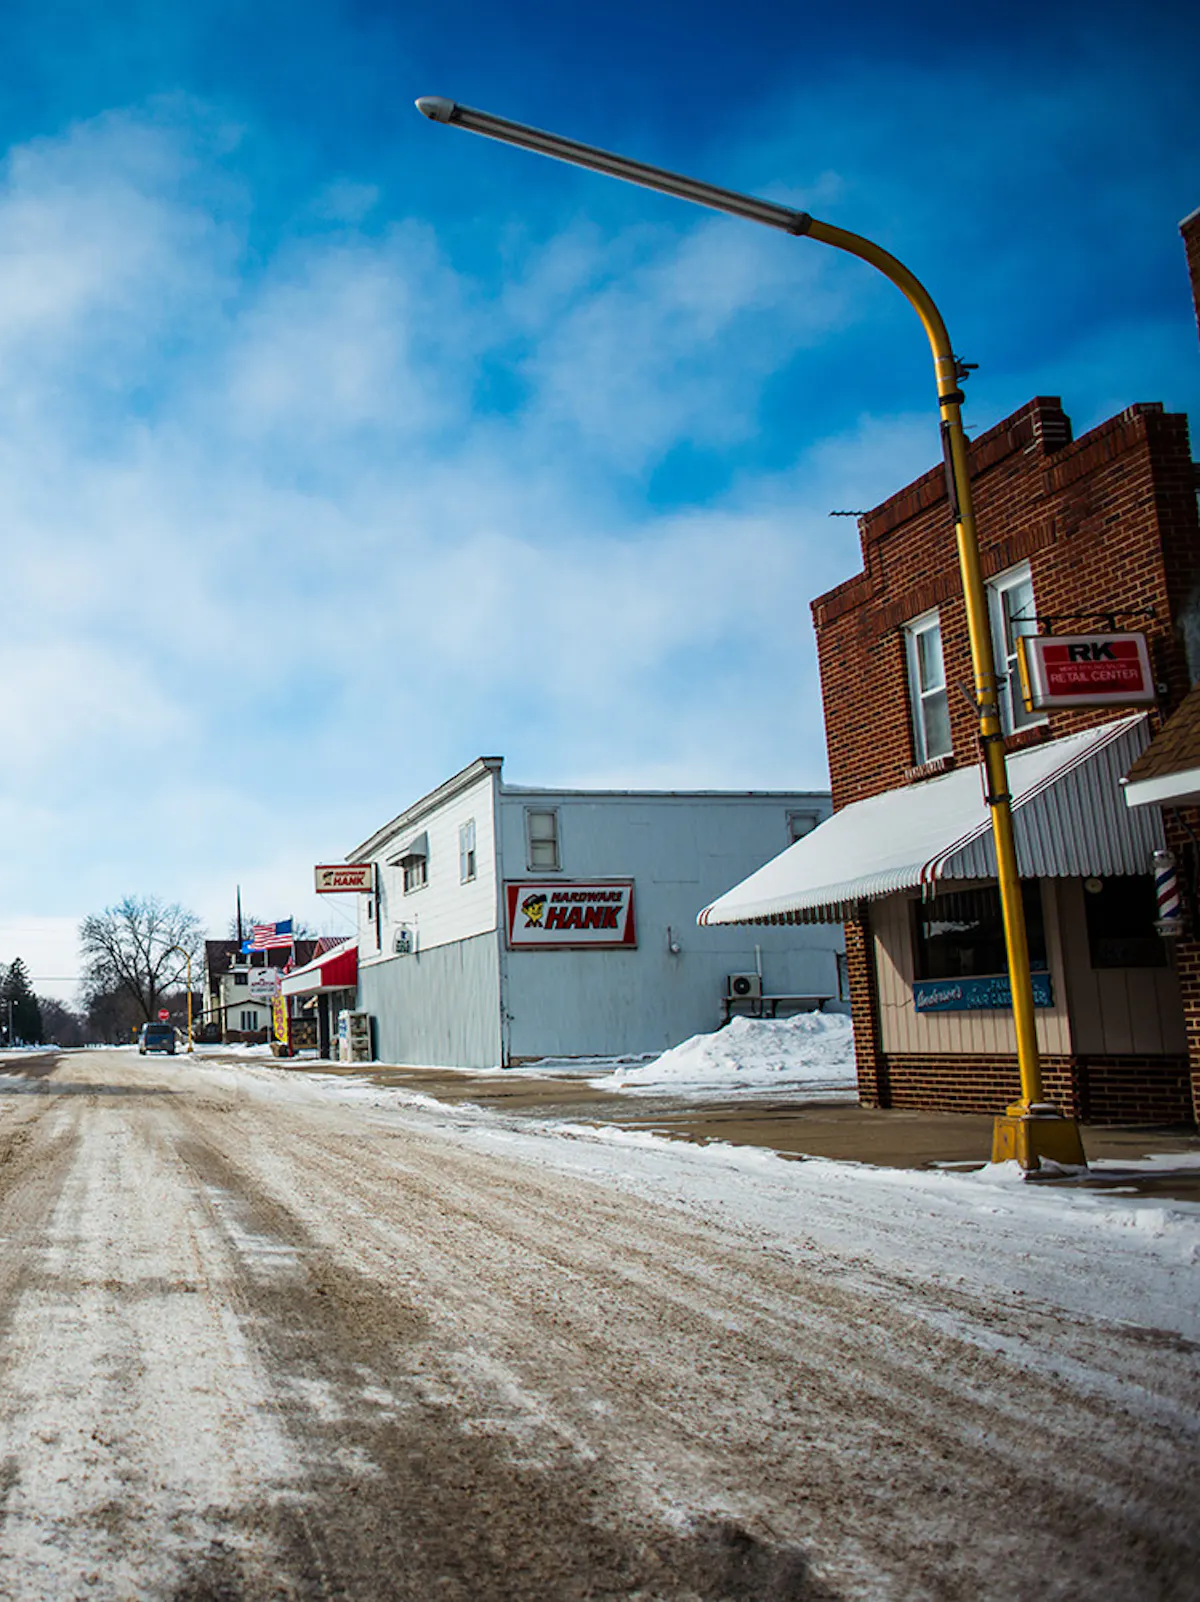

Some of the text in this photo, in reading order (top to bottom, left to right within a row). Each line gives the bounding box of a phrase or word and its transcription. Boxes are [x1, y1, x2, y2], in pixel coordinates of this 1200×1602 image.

[1068, 642, 1117, 662] RK
[1050, 669, 1138, 683] RETAIL CENTER
[333, 876, 365, 886] HANK
[550, 891, 623, 903] HARDWARE
[543, 906, 624, 930] HANK
